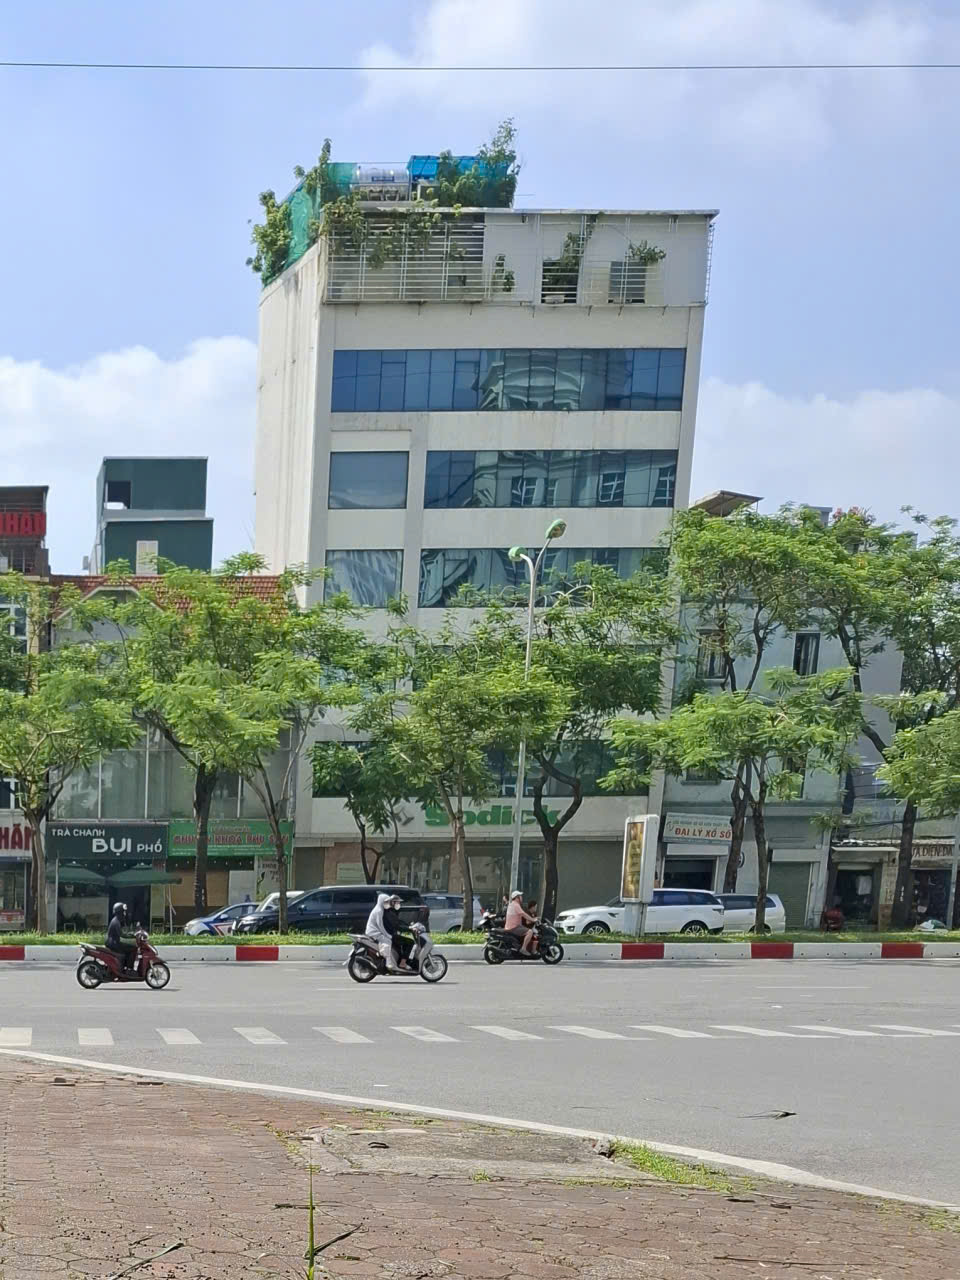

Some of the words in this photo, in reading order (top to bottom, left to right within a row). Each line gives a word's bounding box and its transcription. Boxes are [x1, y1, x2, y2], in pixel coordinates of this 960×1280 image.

[52, 828, 71, 837] TRÀ
[73, 828, 106, 837] CHANH
[675, 827, 690, 837] ĐẠI
[692, 827, 703, 836] LÝ
[705, 828, 717, 838] XỔ
[720, 830, 732, 838] SỐ
[92, 837, 132, 856] BỤI
[136, 838, 163, 854] PHỐ
